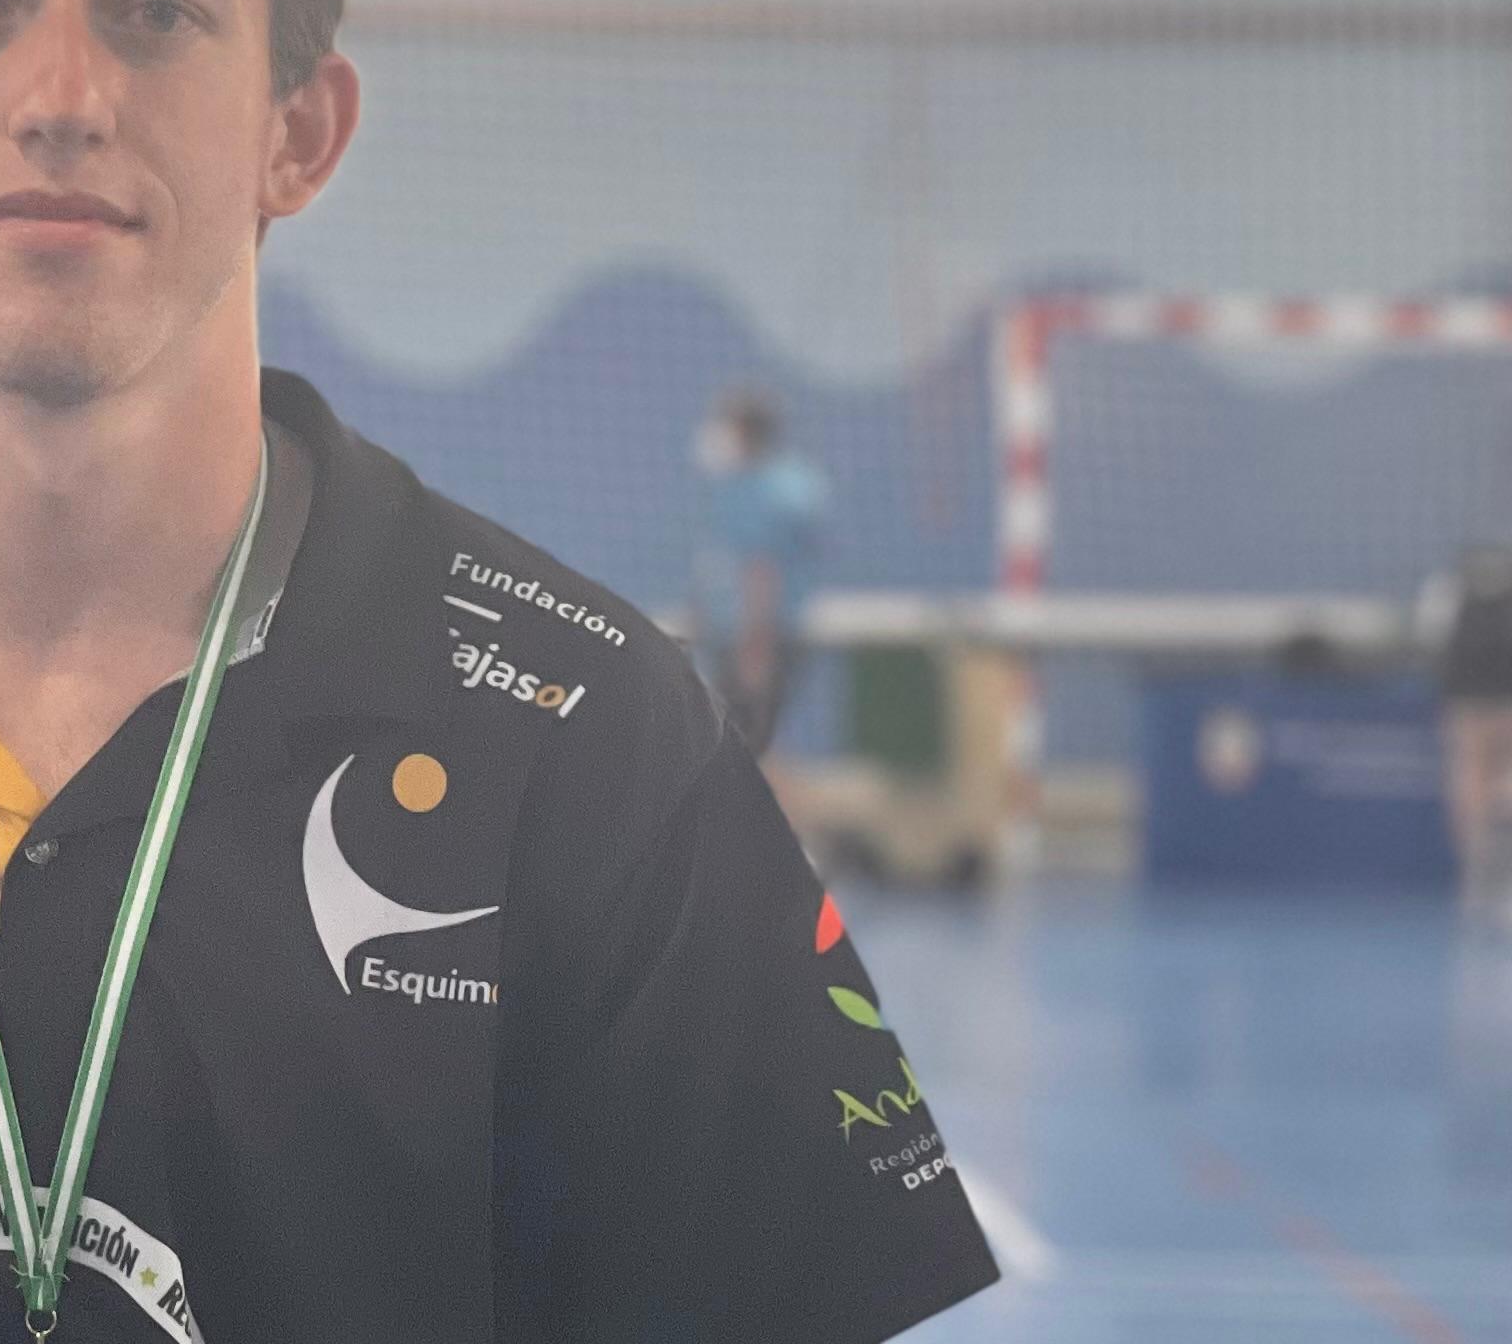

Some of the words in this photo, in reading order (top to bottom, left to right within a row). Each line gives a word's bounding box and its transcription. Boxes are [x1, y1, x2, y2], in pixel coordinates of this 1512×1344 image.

[449, 552, 626, 647] Fundación
[448, 628, 586, 718] ajasol
[361, 957, 499, 1004] Esquim
